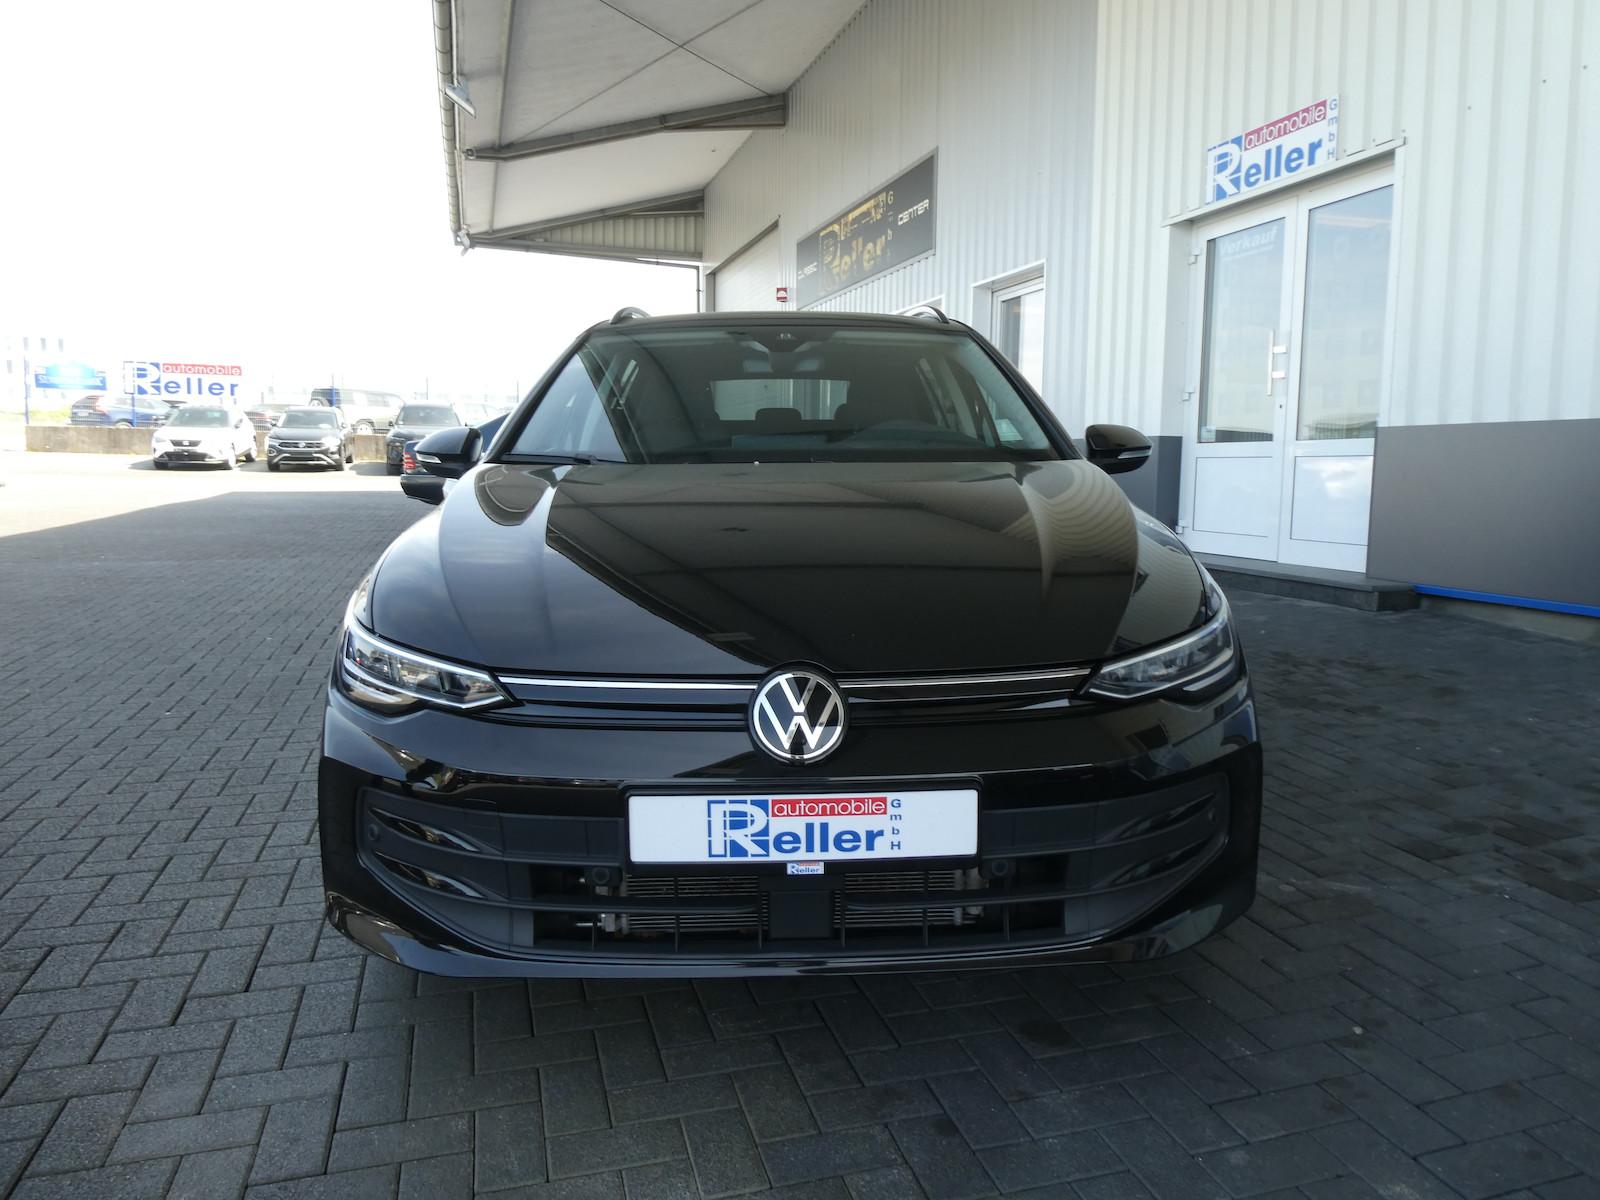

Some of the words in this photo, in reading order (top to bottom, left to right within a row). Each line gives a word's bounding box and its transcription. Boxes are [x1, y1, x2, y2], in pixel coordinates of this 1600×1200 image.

[1244, 104, 1326, 149] automobile
[1205, 135, 1323, 204] Reller
[1219, 225, 1279, 257] Verkauf
[124, 361, 239, 397] Reller
[162, 363, 241, 376] automobile
[773, 799, 886, 816] automobile
[890, 798, 902, 850] GmbH
[707, 799, 885, 858] Reller
